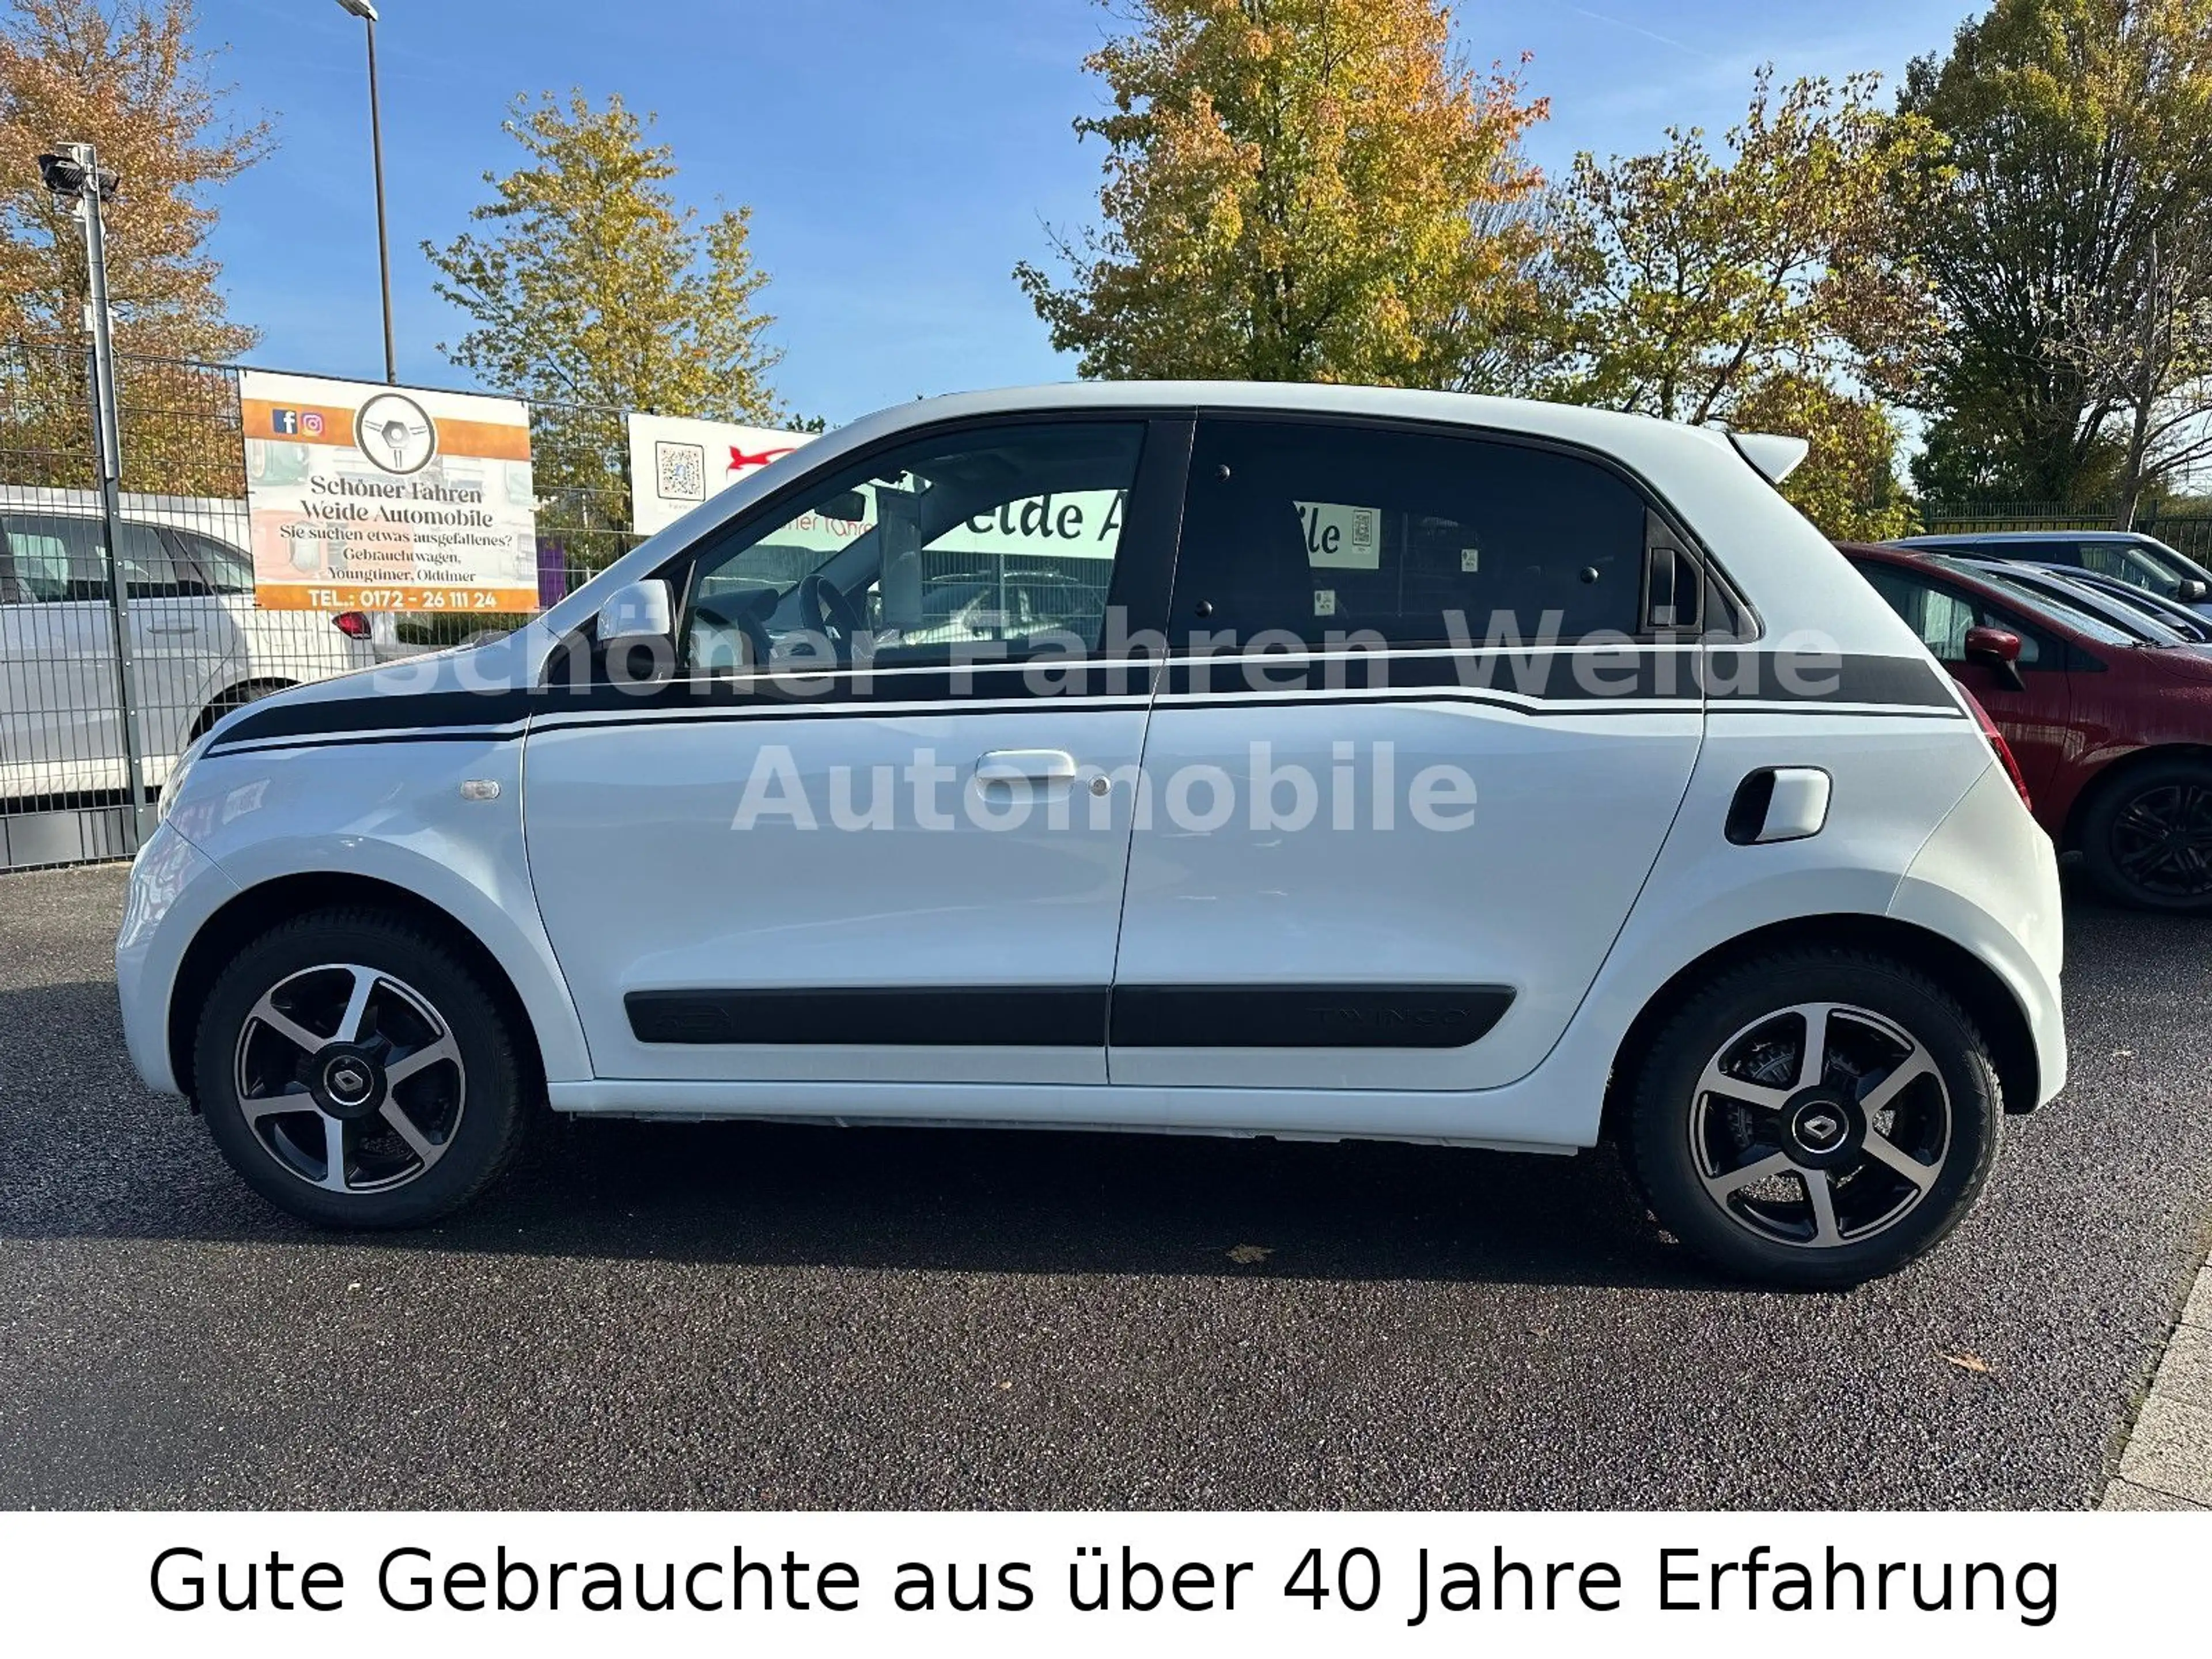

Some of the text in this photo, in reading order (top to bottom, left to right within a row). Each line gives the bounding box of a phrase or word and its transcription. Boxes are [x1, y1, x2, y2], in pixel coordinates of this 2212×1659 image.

[310, 475, 482, 504] Schöner Fahren
[301, 500, 493, 527] Weide Automobile
[280, 524, 513, 547] Sie suchen etwas ausgefallenes?
[343, 548, 461, 566] Gebrauchtwagen,
[327, 566, 476, 583] Youngtimer, Oldtimer
[308, 589, 355, 607] TEL.:
[359, 590, 404, 608] 0172
[422, 592, 445, 608] 26
[449, 593, 469, 608] 111
[474, 593, 497, 608] 24
